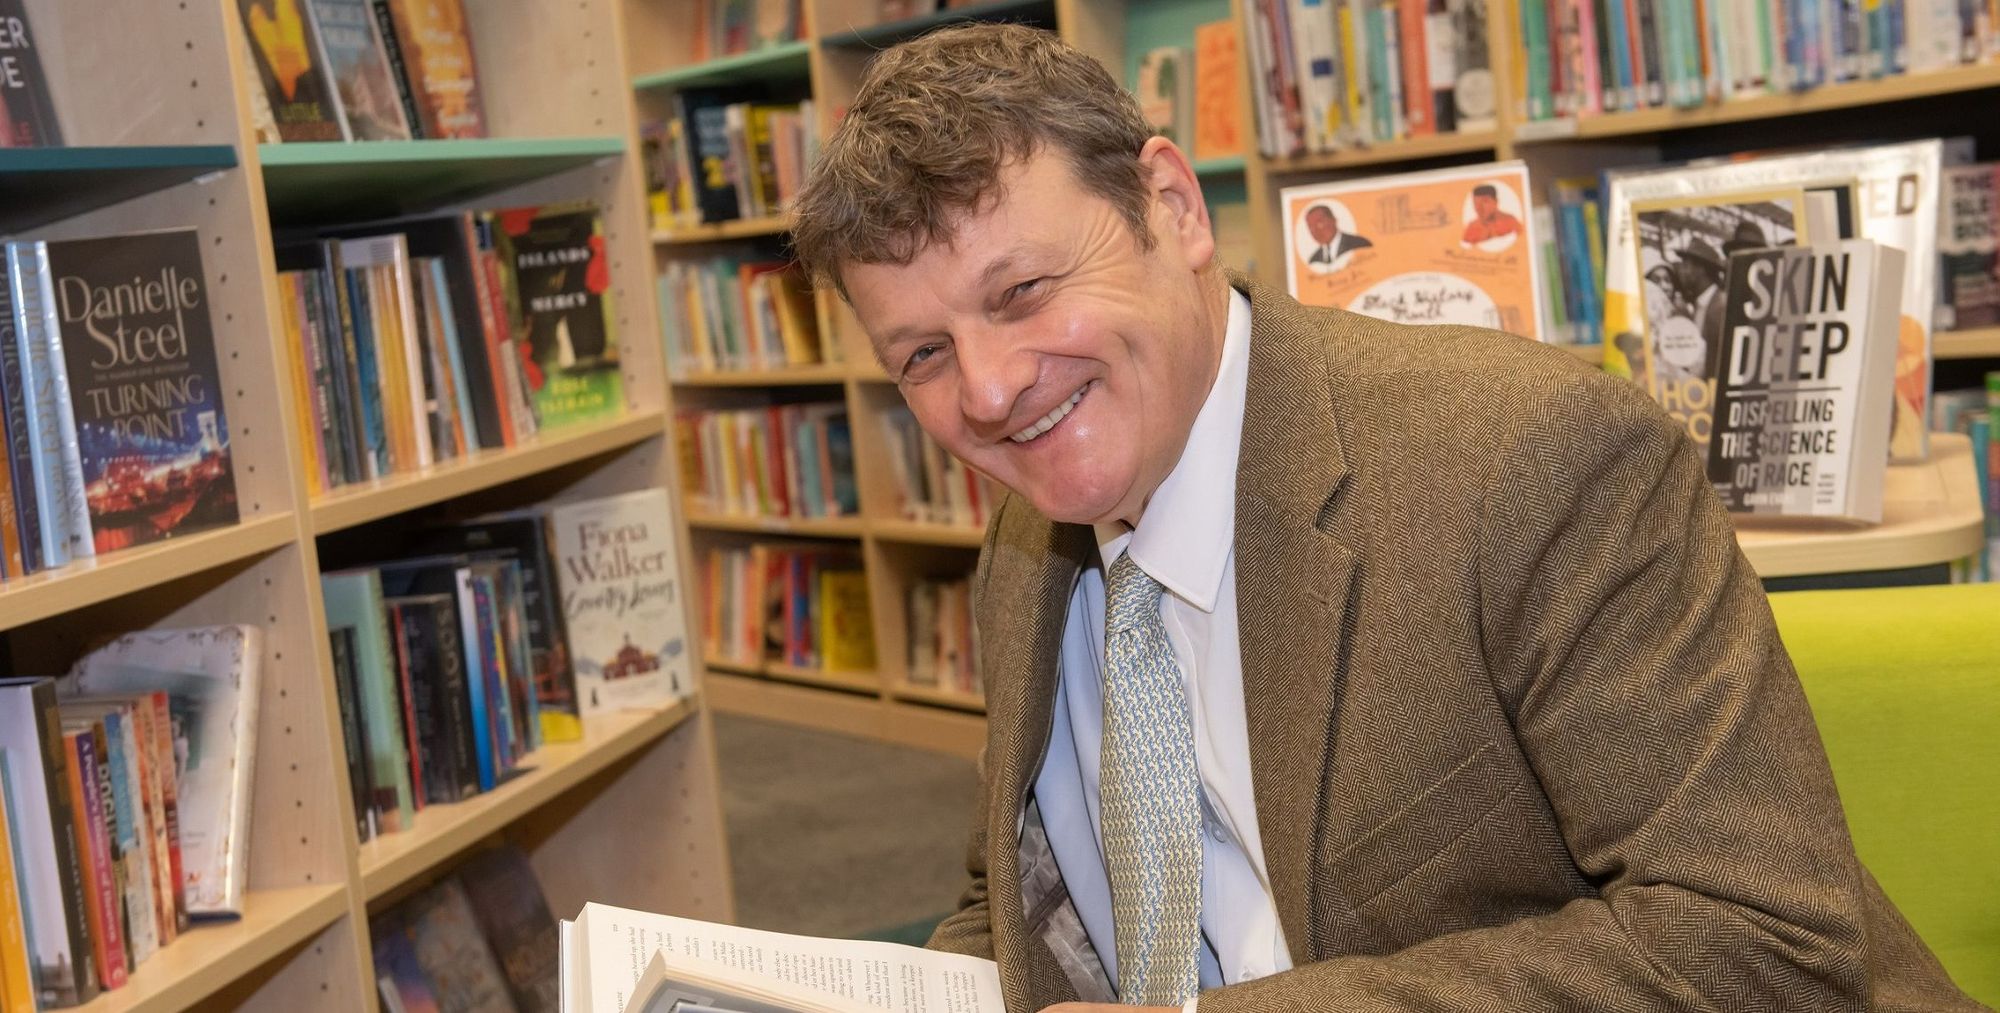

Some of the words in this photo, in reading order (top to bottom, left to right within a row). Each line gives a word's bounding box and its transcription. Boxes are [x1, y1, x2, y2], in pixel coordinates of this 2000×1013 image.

[518, 247, 591, 269] ISLANDS
[59, 266, 199, 323] Danielle
[531, 292, 587, 312] MERCY
[1743, 251, 1851, 321] SKIN
[86, 309, 188, 370] Steel
[1727, 320, 1849, 386] DEEP
[86, 374, 205, 418] TURNING
[1728, 399, 1835, 428] DISPELLING
[114, 408, 188, 447] POINT
[1720, 432, 1754, 459] THE
[1757, 430, 1837, 456] SCIENCE
[1735, 462, 1759, 489] OF
[1763, 462, 1812, 488] RACE
[578, 521, 648, 551] Fiona
[566, 546, 667, 584] Walker
